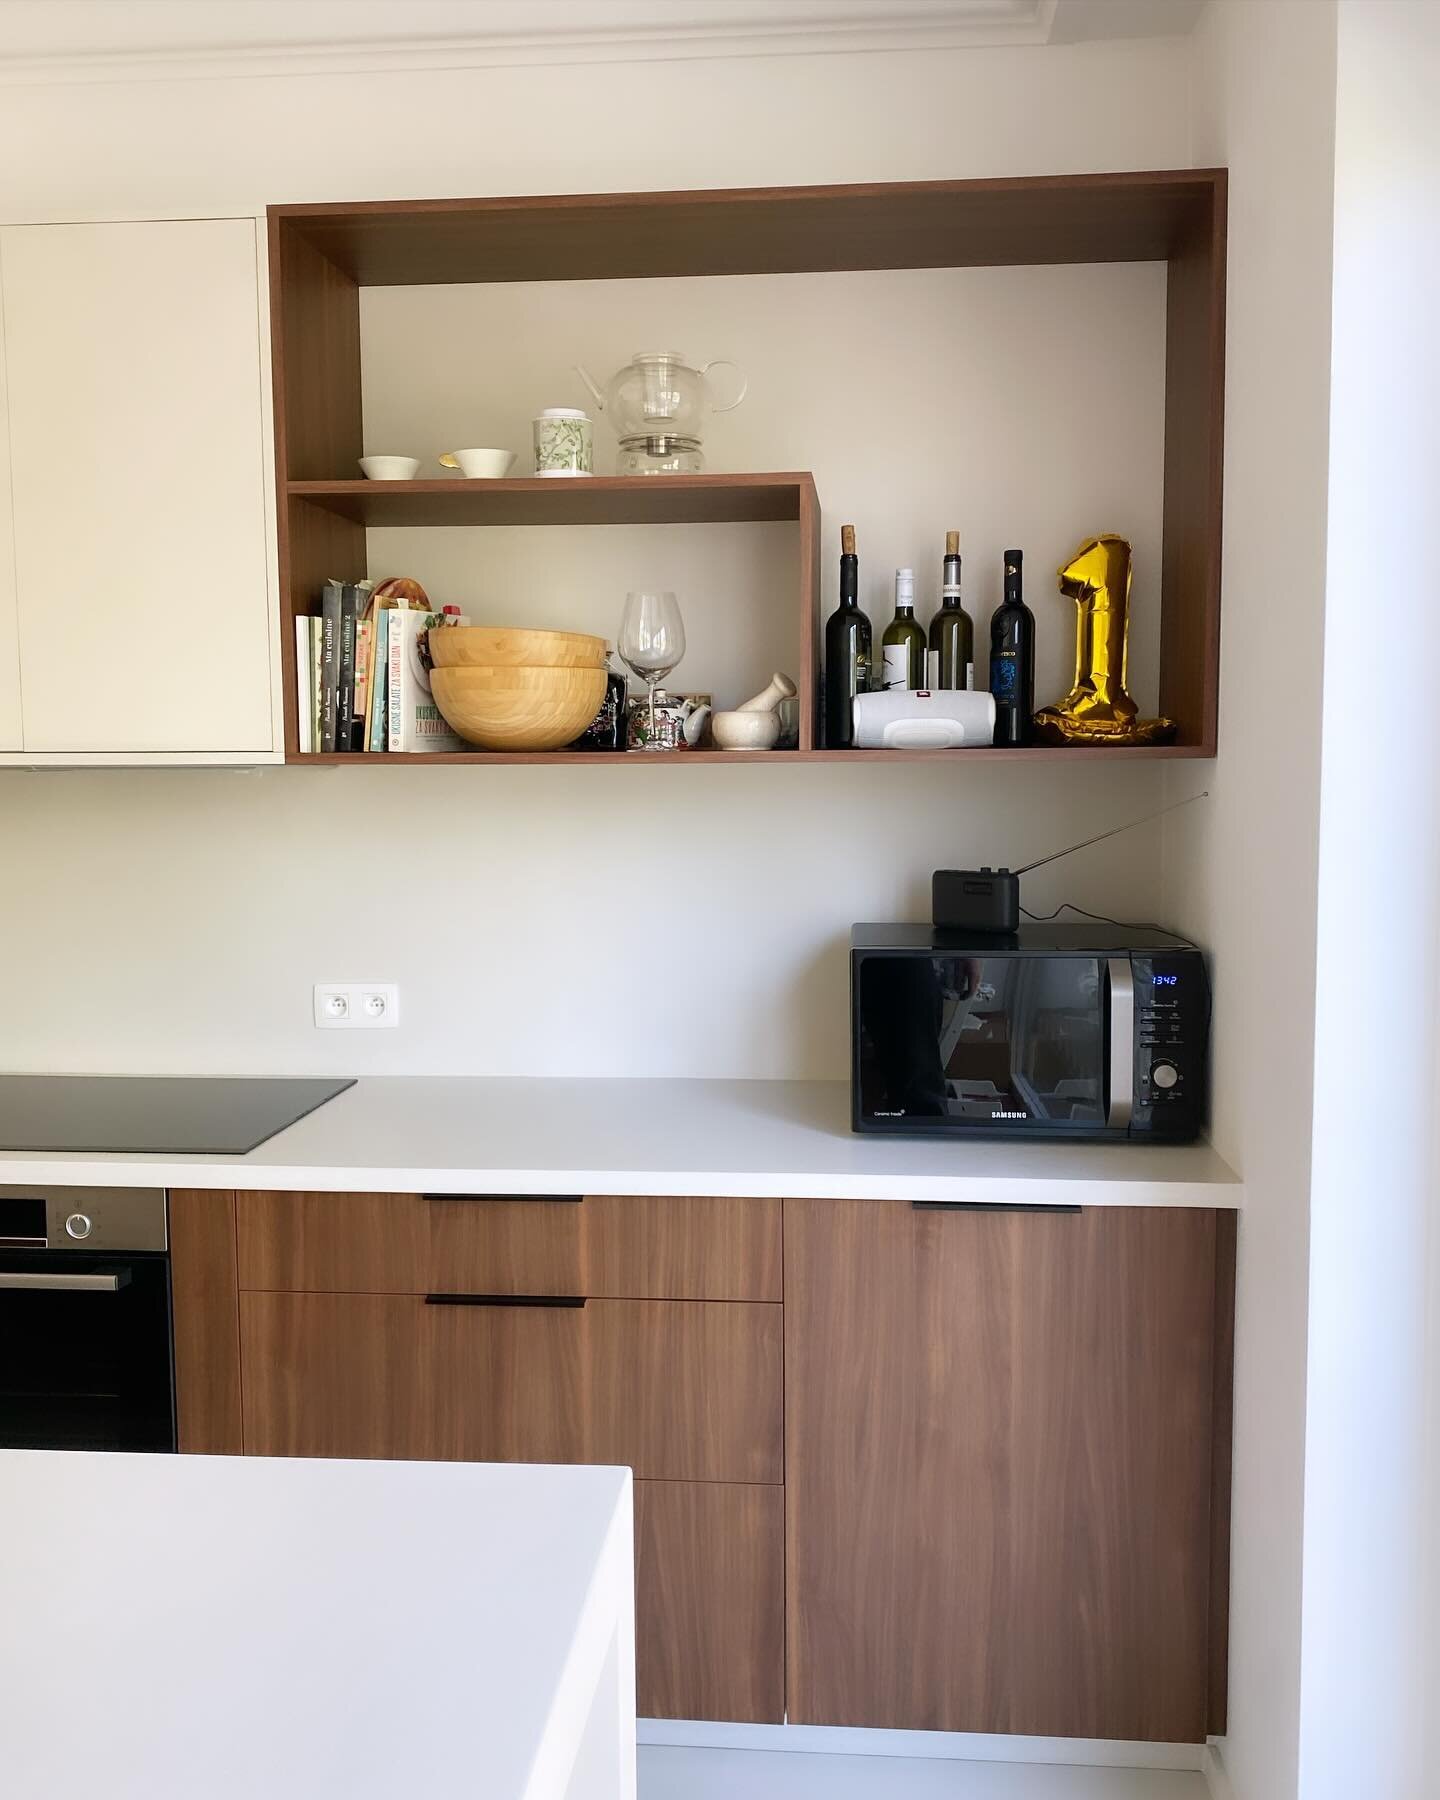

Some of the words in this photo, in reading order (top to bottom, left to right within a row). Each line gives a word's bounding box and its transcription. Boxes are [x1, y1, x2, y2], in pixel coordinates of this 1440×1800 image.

[325, 618, 333, 650] cuisine
[343, 621, 351, 652] cuisine
[325, 651, 333, 664] Ma
[343, 654, 351, 665] Ma
[392, 678, 401, 687] ZA
[391, 689, 401, 710] SALATE
[391, 711, 401, 735] UKUSNE
[991, 1111, 1027, 1119] SAMSUNG
